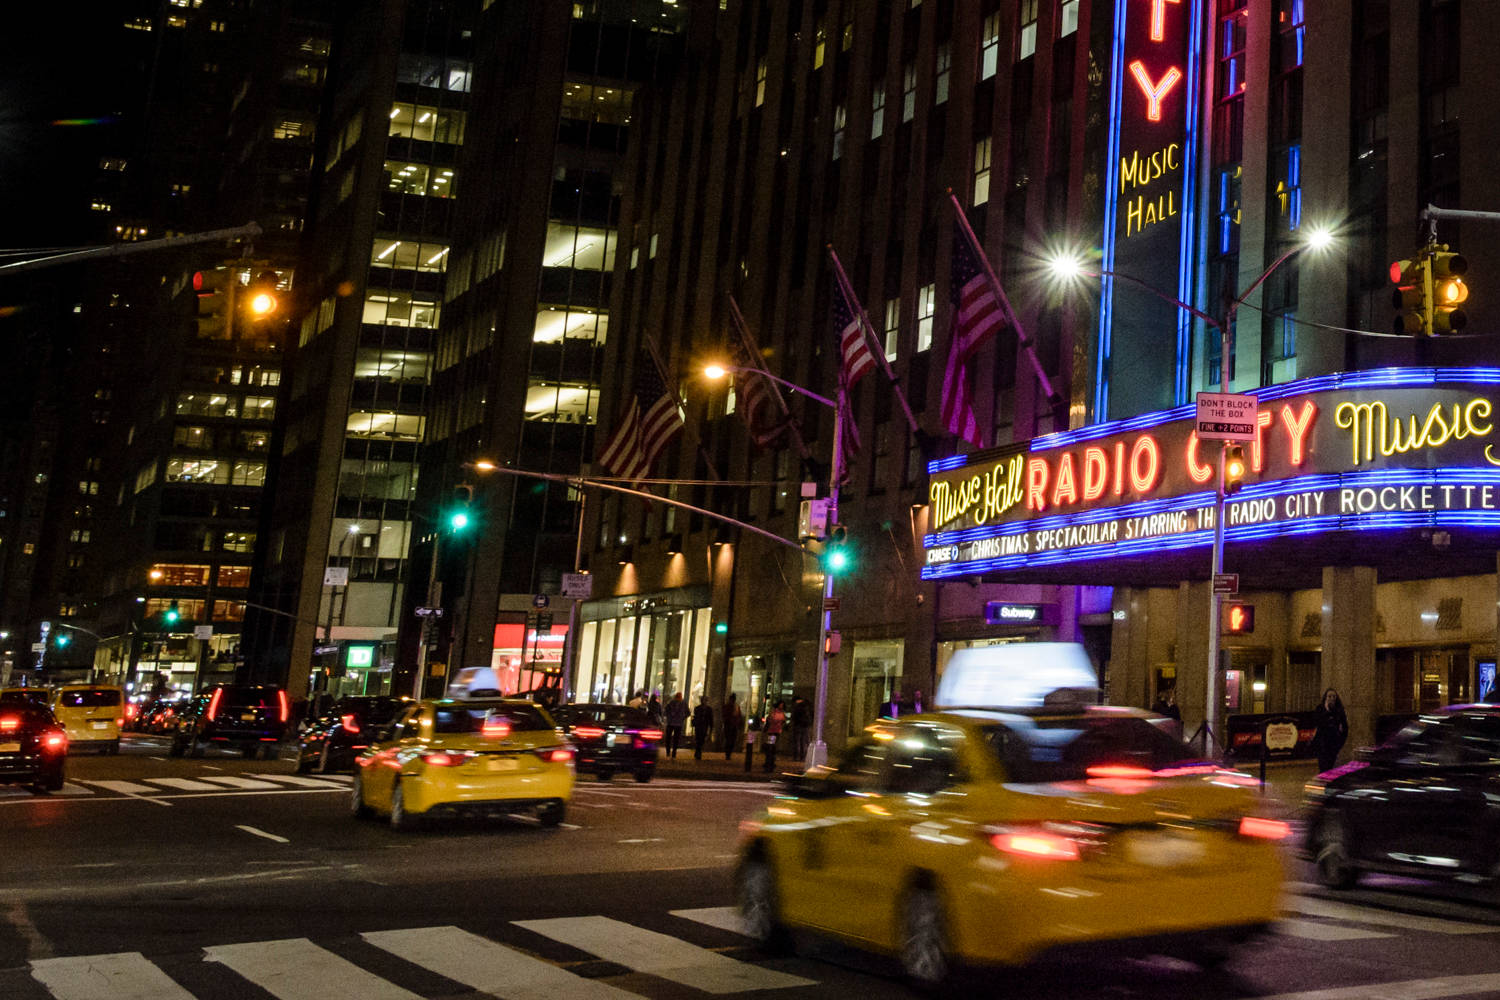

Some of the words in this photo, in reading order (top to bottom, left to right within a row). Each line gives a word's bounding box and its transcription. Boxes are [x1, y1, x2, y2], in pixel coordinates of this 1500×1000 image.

[1120, 143, 1179, 195] MUSIC
[1126, 190, 1177, 239] HALL
[1211, 409, 1226, 417] THE
[1228, 410, 1244, 418] BOX
[1227, 400, 1253, 409] BLOCK
[1201, 423, 1216, 432] FINE
[1230, 425, 1252, 433] POINTS
[1335, 398, 1492, 466] Music
[1024, 434, 1159, 513] RADIO
[1186, 399, 1317, 484] CTY
[929, 475, 981, 530] Music
[973, 453, 1024, 525] Hall
[971, 534, 1029, 561] CHRISTMAS
[1035, 522, 1118, 552] SPECTACULAR
[1125, 511, 1188, 539] STARRING
[1197, 507, 1216, 529] TH
[1230, 498, 1276, 525] RADIO
[1286, 491, 1324, 518] CITY
[927, 547, 952, 563] CHASE
[1000, 606, 1037, 620] Subway
[350, 649, 370, 664] TD
